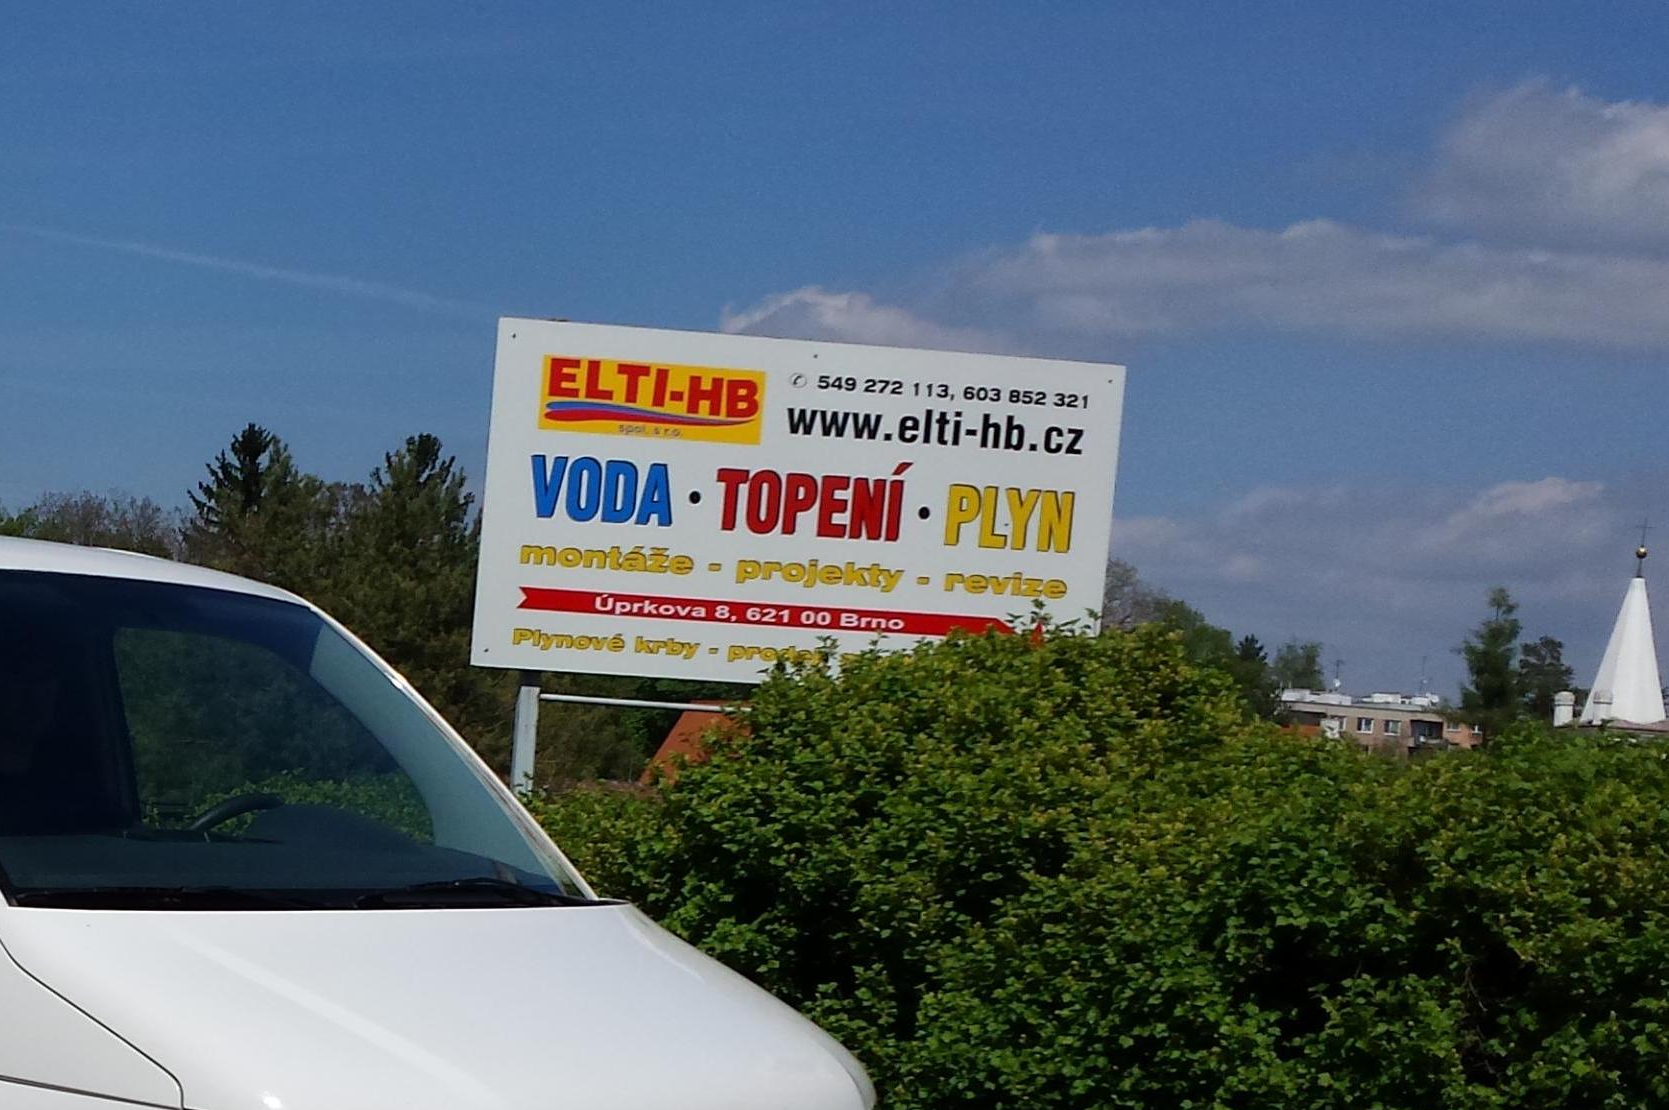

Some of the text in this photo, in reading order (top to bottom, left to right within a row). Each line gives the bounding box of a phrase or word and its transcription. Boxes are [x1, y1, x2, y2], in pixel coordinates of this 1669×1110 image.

[548, 357, 760, 419] ELTI-HB
[817, 375, 1089, 409] 549 272 113, 603 852 321
[787, 406, 1084, 455] www.elti-hb.cz
[531, 454, 1076, 554] VODA TOPENÍ PLYN
[518, 543, 695, 576] montáže
[735, 558, 905, 593] projekty
[944, 572, 1068, 599] revize
[594, 592, 905, 630] Úprkova 8, 621 00 Brno
[512, 627, 626, 652] Plynové
[634, 635, 701, 659] krby
